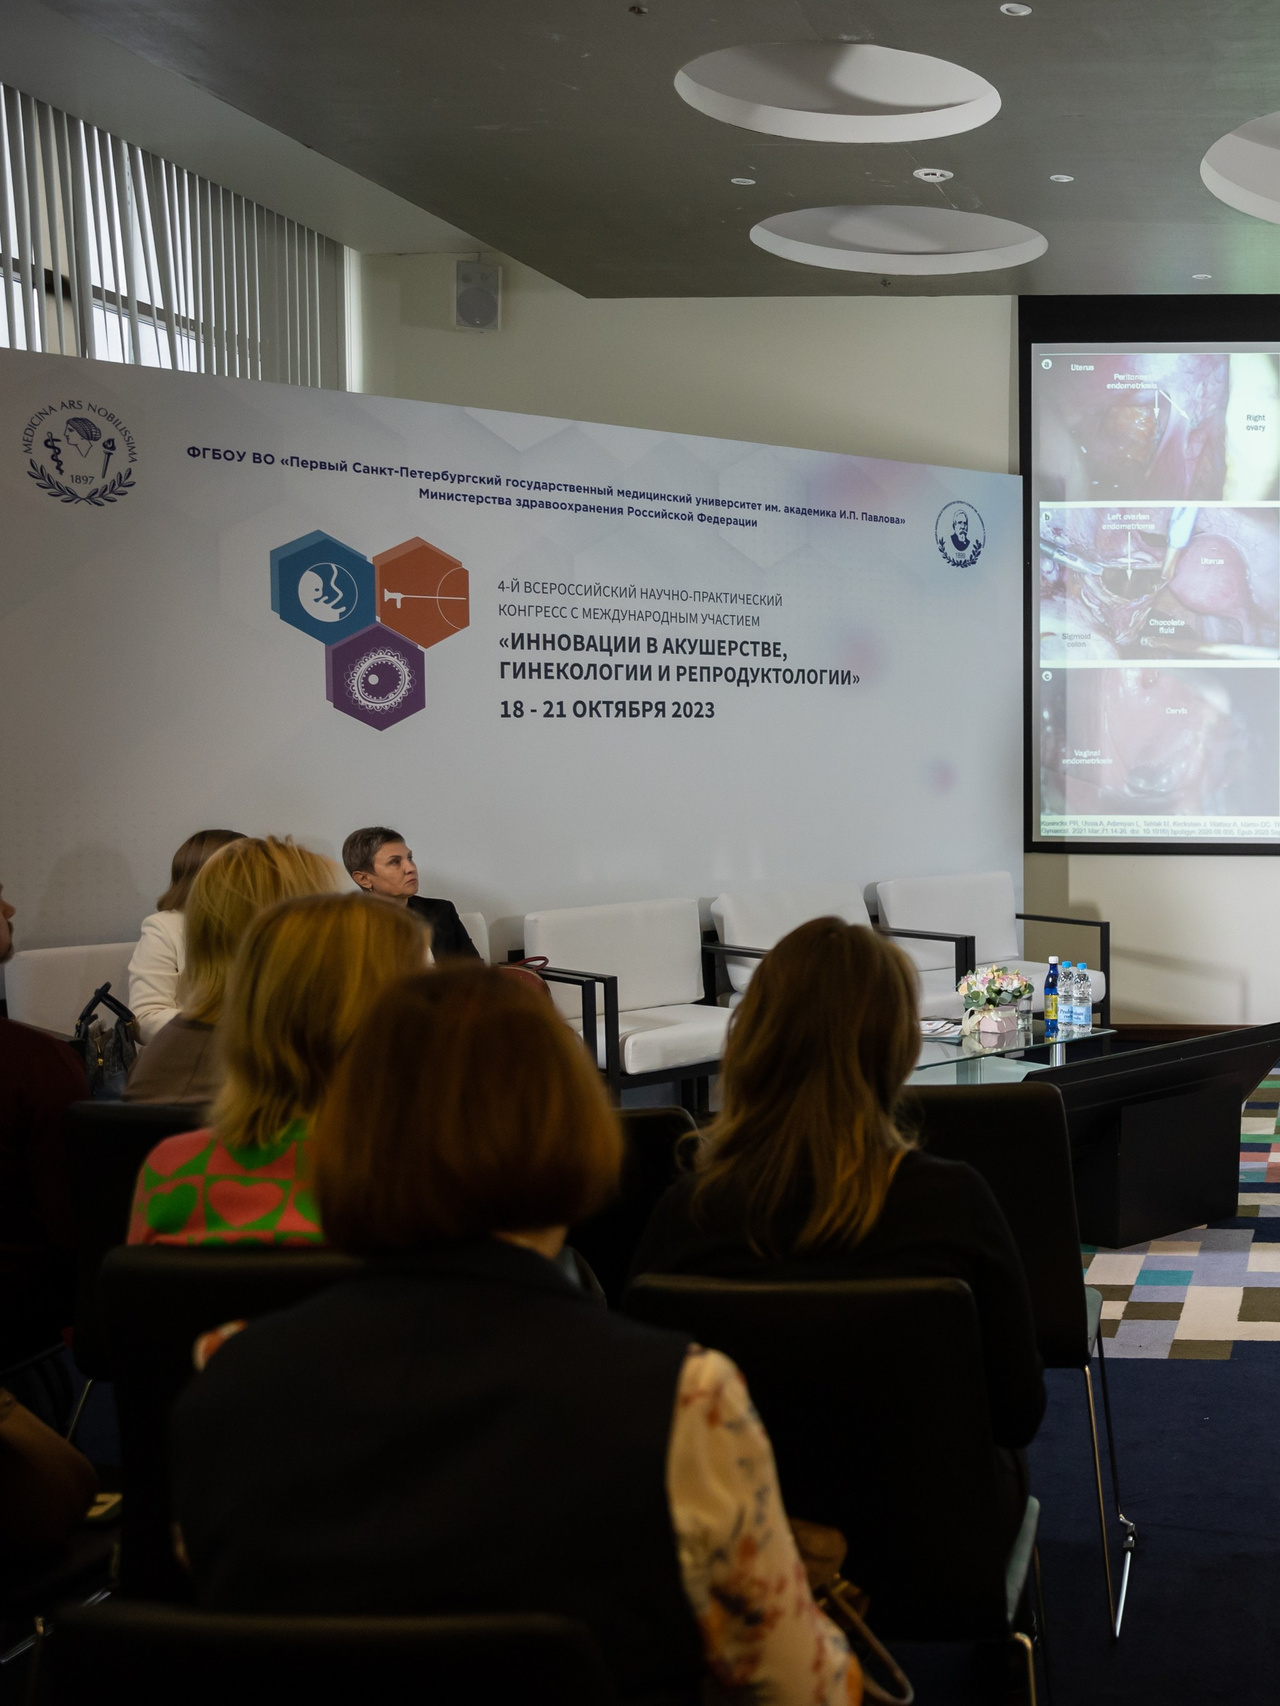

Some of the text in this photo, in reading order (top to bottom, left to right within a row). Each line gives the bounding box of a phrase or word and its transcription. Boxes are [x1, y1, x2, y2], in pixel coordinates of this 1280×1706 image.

[1070, 363, 1095, 371] Uterus
[1246, 414, 1266, 424] Right
[22, 399, 139, 464] MEDICINA ARS NOBILISSIMA
[1245, 424, 1266, 432] ovary
[69, 474, 95, 485] 1897
[187, 444, 905, 524] ФГБОУ ВО «Первый Санкт-Петербургский государственный медицинский университет им. академика И.П. Павлова»
[419, 487, 757, 527] Министерства здравоохранения Российской Федерации
[1200, 557, 1225, 565] Uterus
[498, 577, 782, 606] 4-Й ВСЕРОССИЙСКИЙ НАУЧНО-ПРАКТИЧЕСКИЙ
[499, 603, 759, 626] КОНГРЕСС С МЕЖДУНАРОДНЫМ УЧАСТИЕМ
[1149, 618, 1186, 627] Chocolate
[1061, 632, 1092, 641] Sigmoid
[500, 633, 787, 660] «ИННОВАЦИИ В АКУШЕРСТВЕ,
[1066, 640, 1087, 648] colon
[501, 661, 859, 686] ГИНЕКОЛОГИИ И РЕПРОДУКТОЛОГИИ»
[501, 700, 714, 717] 18 21 ОКТЯБРЯ 2023
